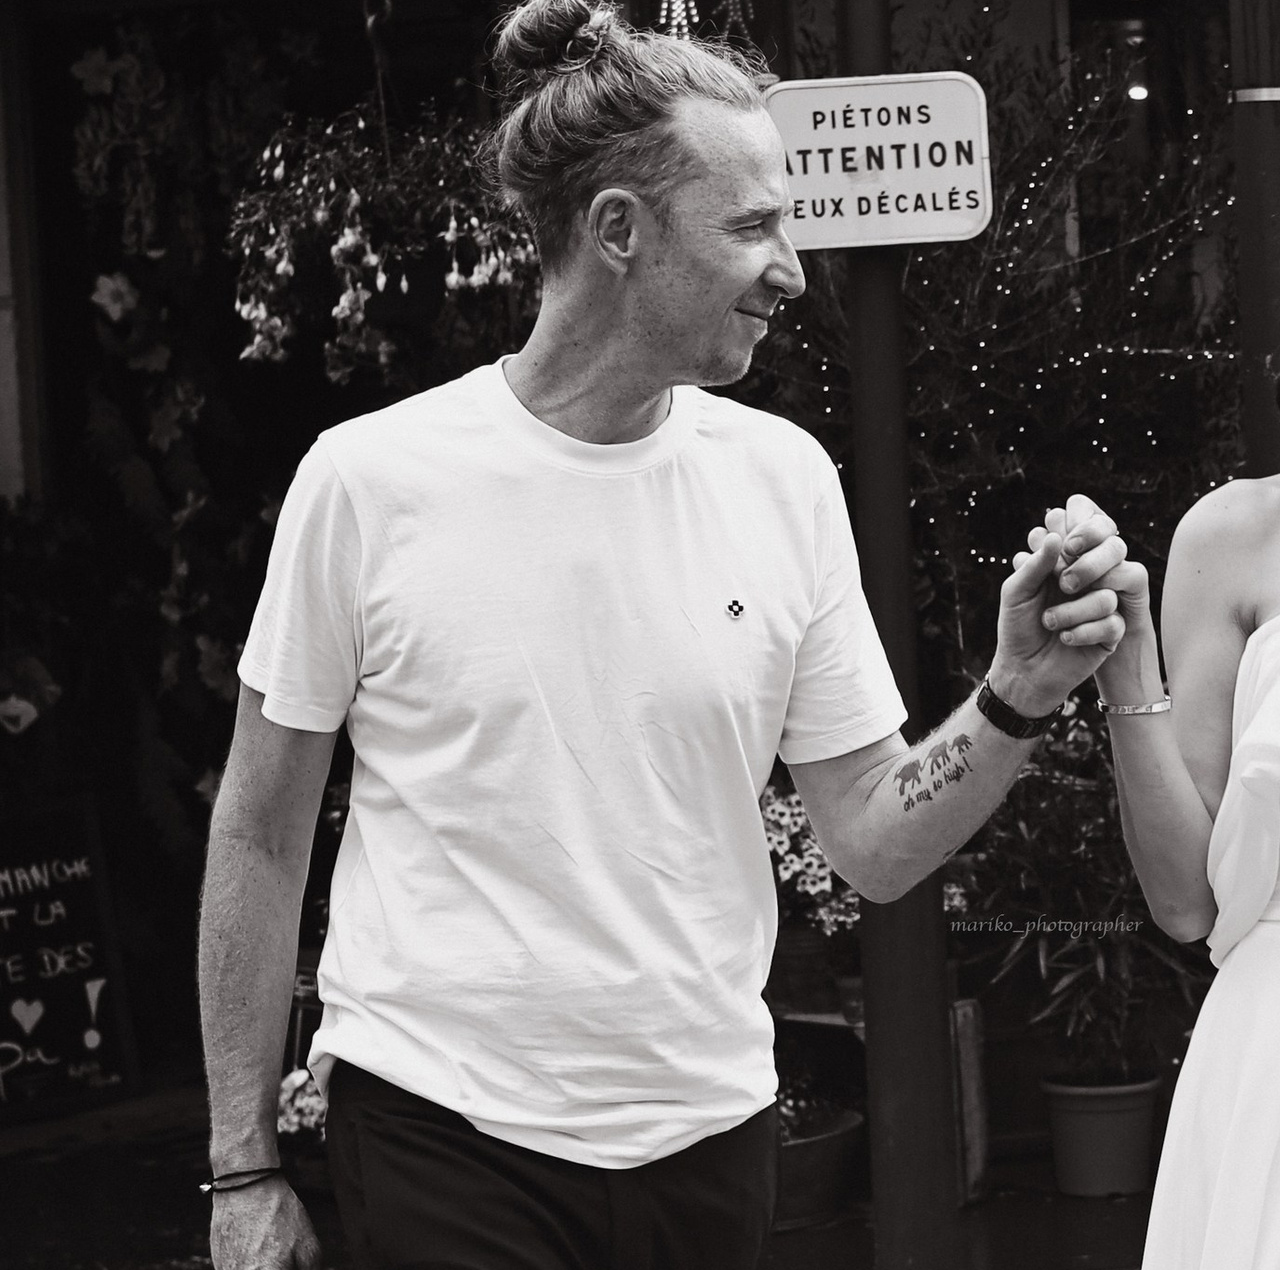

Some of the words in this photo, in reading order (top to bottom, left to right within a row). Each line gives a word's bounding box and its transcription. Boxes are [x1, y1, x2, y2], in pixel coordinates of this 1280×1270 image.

[812, 104, 931, 130] PIÉTONS
[794, 197, 844, 219] EUX
[858, 187, 980, 216] DÉCALÉS
